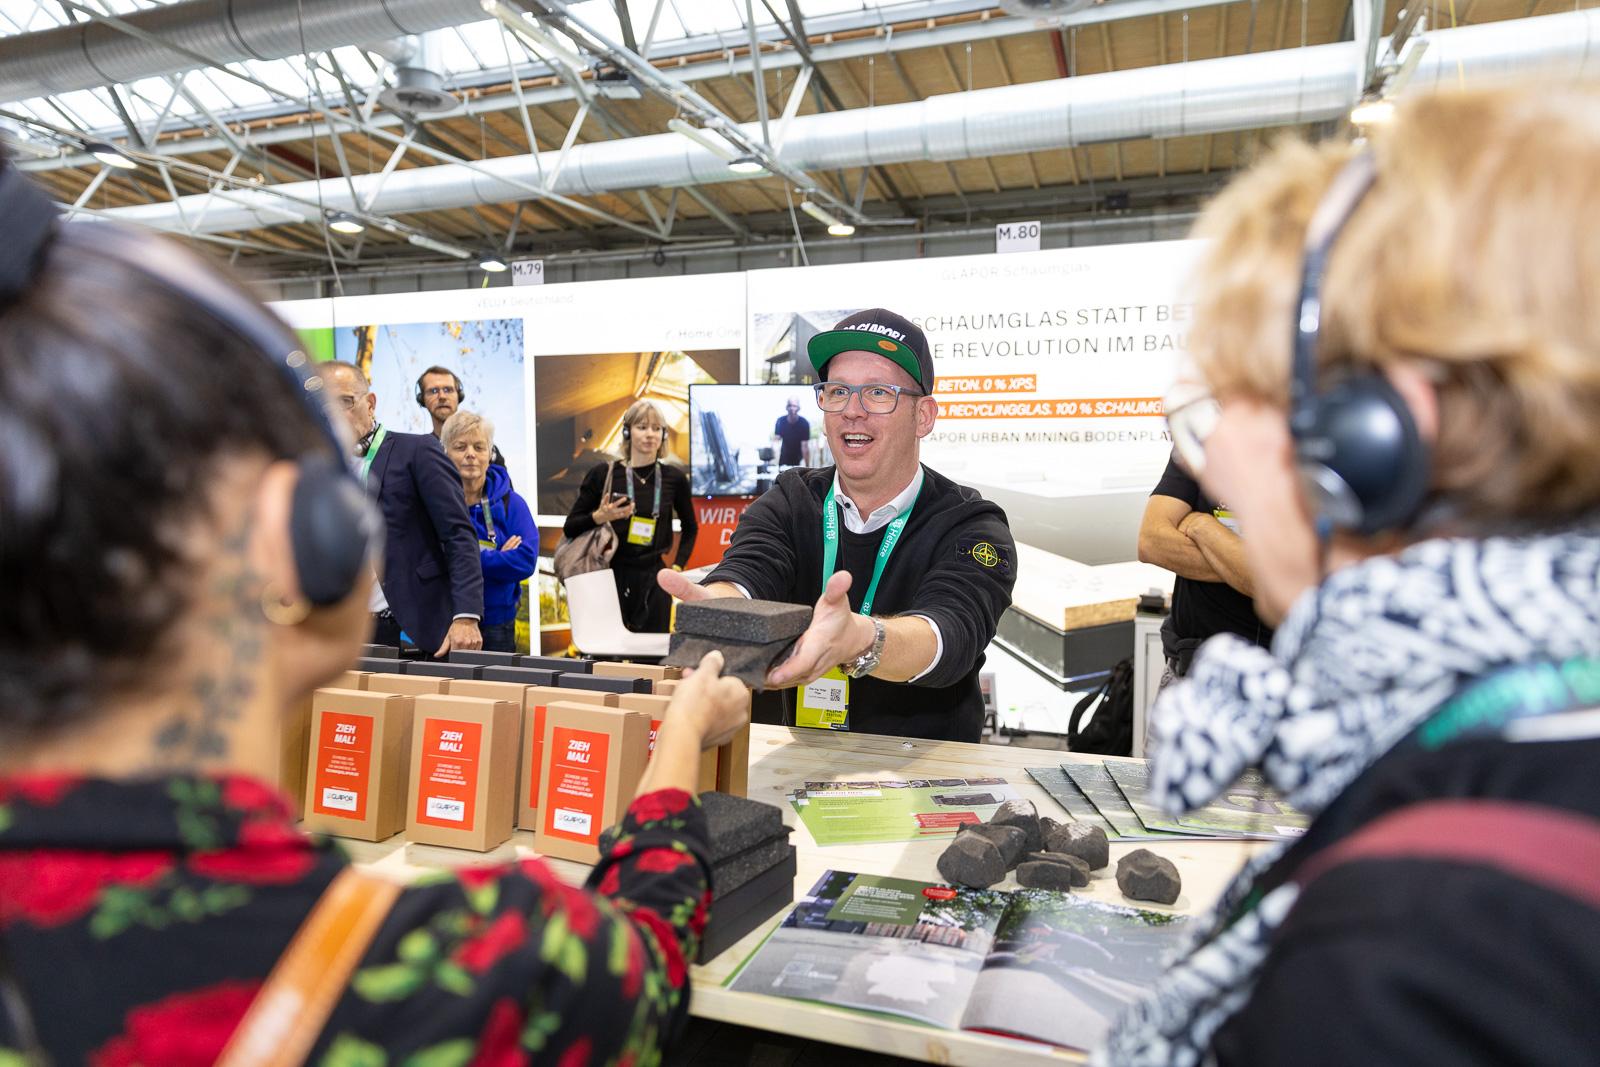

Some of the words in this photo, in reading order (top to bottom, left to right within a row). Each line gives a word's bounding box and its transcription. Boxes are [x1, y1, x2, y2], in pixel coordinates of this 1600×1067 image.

[999, 224, 1039, 241] M.80
[512, 262, 542, 276] M.79
[911, 310, 1068, 332] SCHAUMGLAS
[1076, 306, 1148, 326] STATT
[1156, 302, 1194, 321] BE
[953, 337, 1098, 359] REVOLUTION
[1108, 336, 1134, 353] IM
[937, 378, 981, 392] BETON.
[983, 379, 993, 391] 0
[994, 379, 1007, 391] %
[1008, 377, 1036, 390] XPS.
[948, 402, 1052, 417] RECYCLINGGLAS.
[1055, 402, 1078, 415] 100
[1079, 402, 1093, 415] %
[971, 432, 1020, 443] URBAN
[1025, 430, 1080, 443] MINING
[700, 507, 737, 525] WIR
[826, 500, 835, 530] Heinze
[879, 527, 898, 558] Heinze
[335, 723, 357, 735] ZIEH
[440, 730, 464, 742] ZIEH
[333, 733, 357, 745] MAL!
[567, 739, 591, 752] ZIEH
[438, 740, 464, 753] MAL!
[566, 750, 591, 764] MAL!
